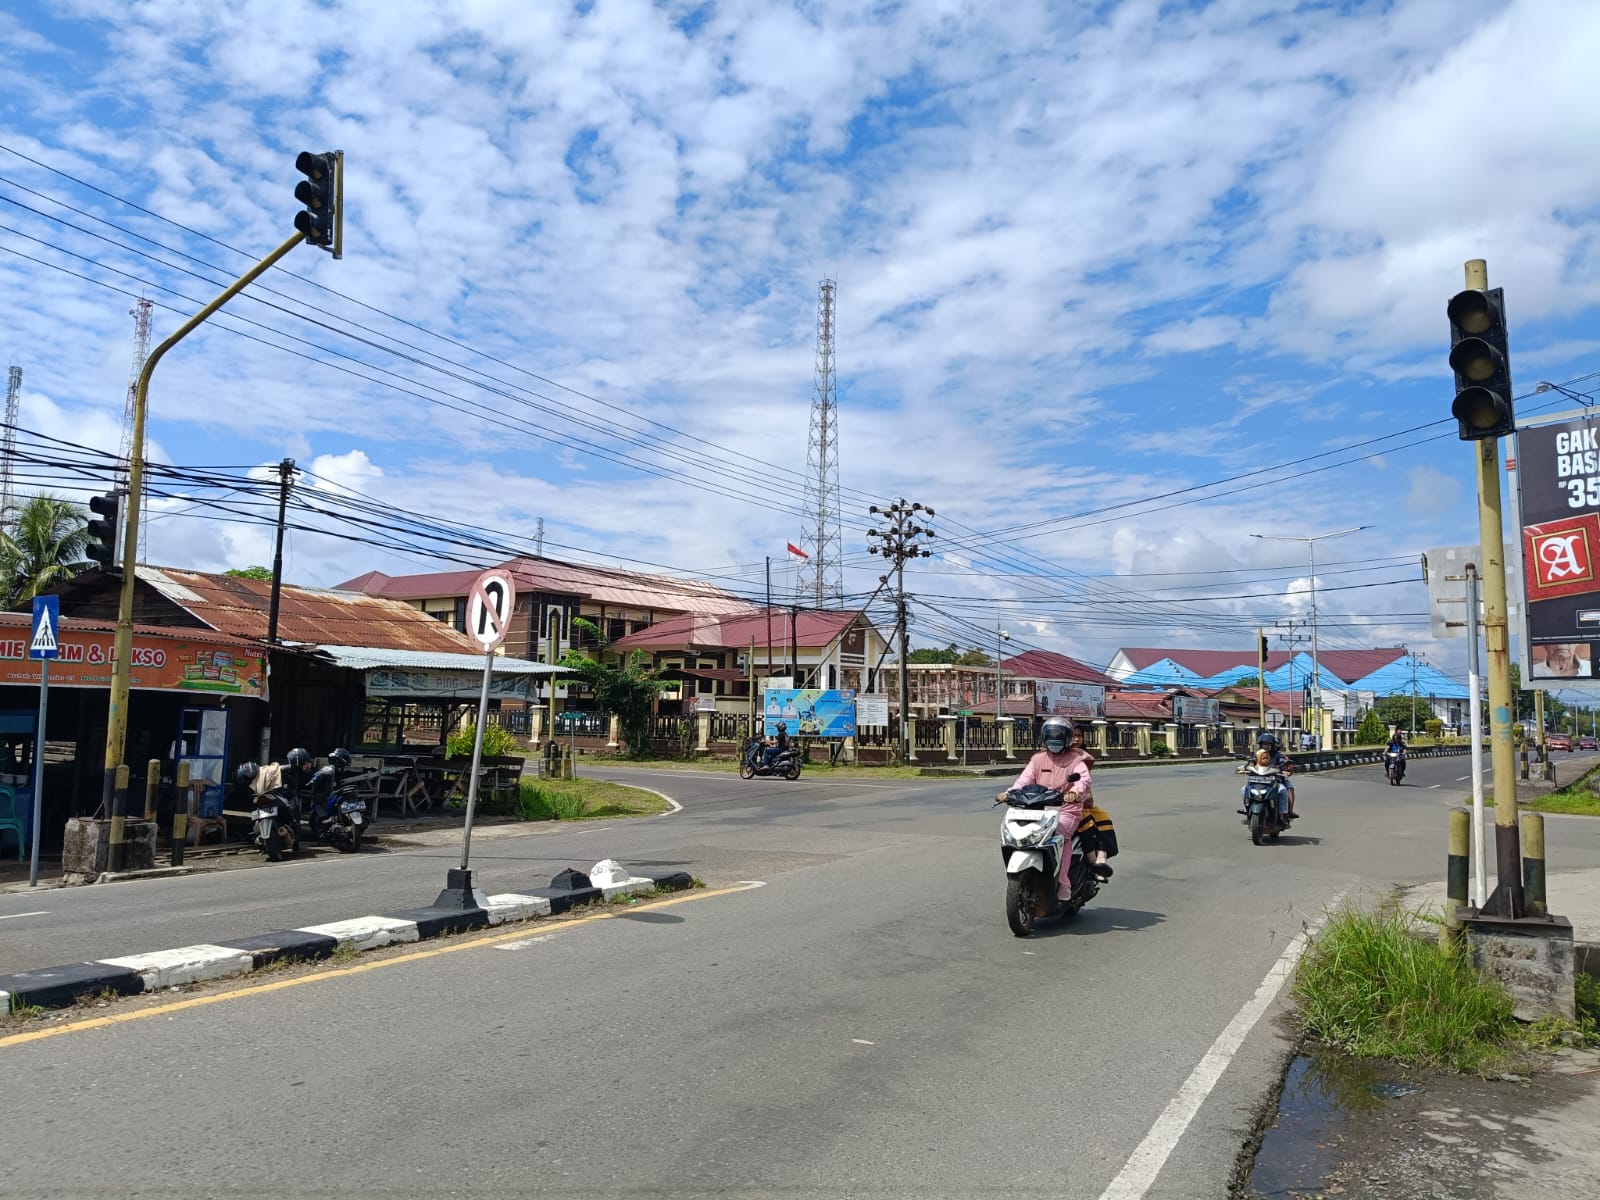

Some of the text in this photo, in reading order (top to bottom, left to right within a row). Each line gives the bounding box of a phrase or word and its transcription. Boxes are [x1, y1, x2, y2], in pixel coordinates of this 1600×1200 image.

[1556, 428, 1598, 454] GAK
[1558, 450, 1600, 477] BAS
[88, 644, 104, 663] &
[109, 647, 165, 667] KSO
